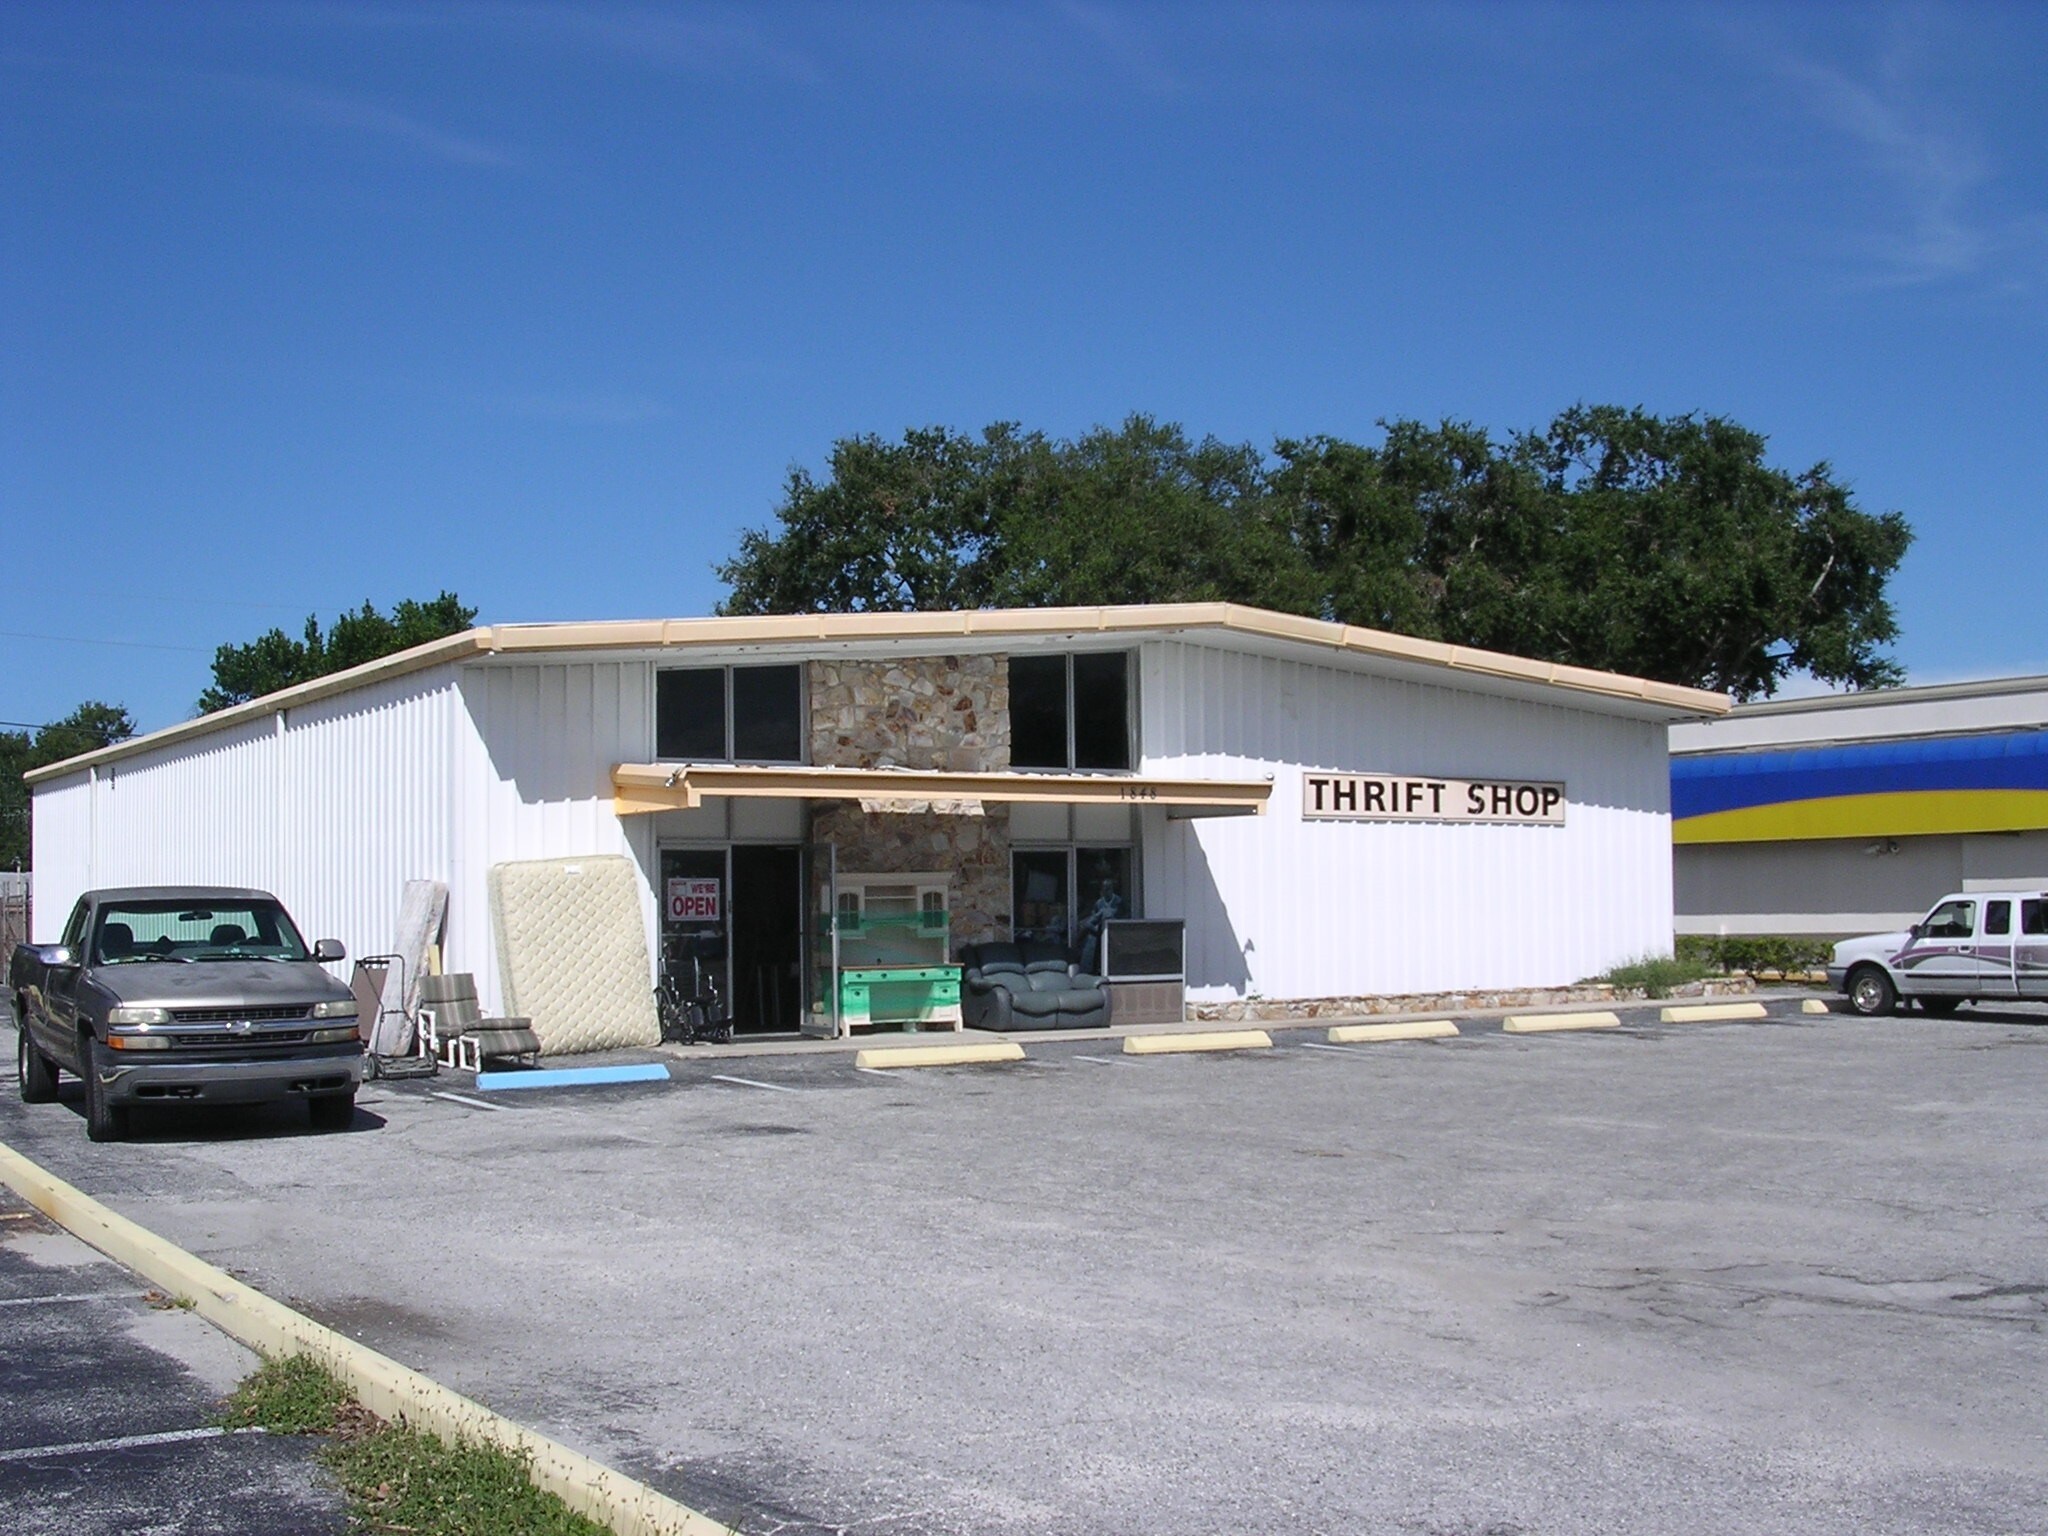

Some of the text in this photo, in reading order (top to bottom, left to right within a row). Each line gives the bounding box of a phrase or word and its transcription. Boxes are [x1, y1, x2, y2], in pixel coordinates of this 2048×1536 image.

[1120, 786, 1157, 800] 1848
[1309, 779, 1560, 816] THRIFT SHOP
[672, 896, 716, 916] OPEN
